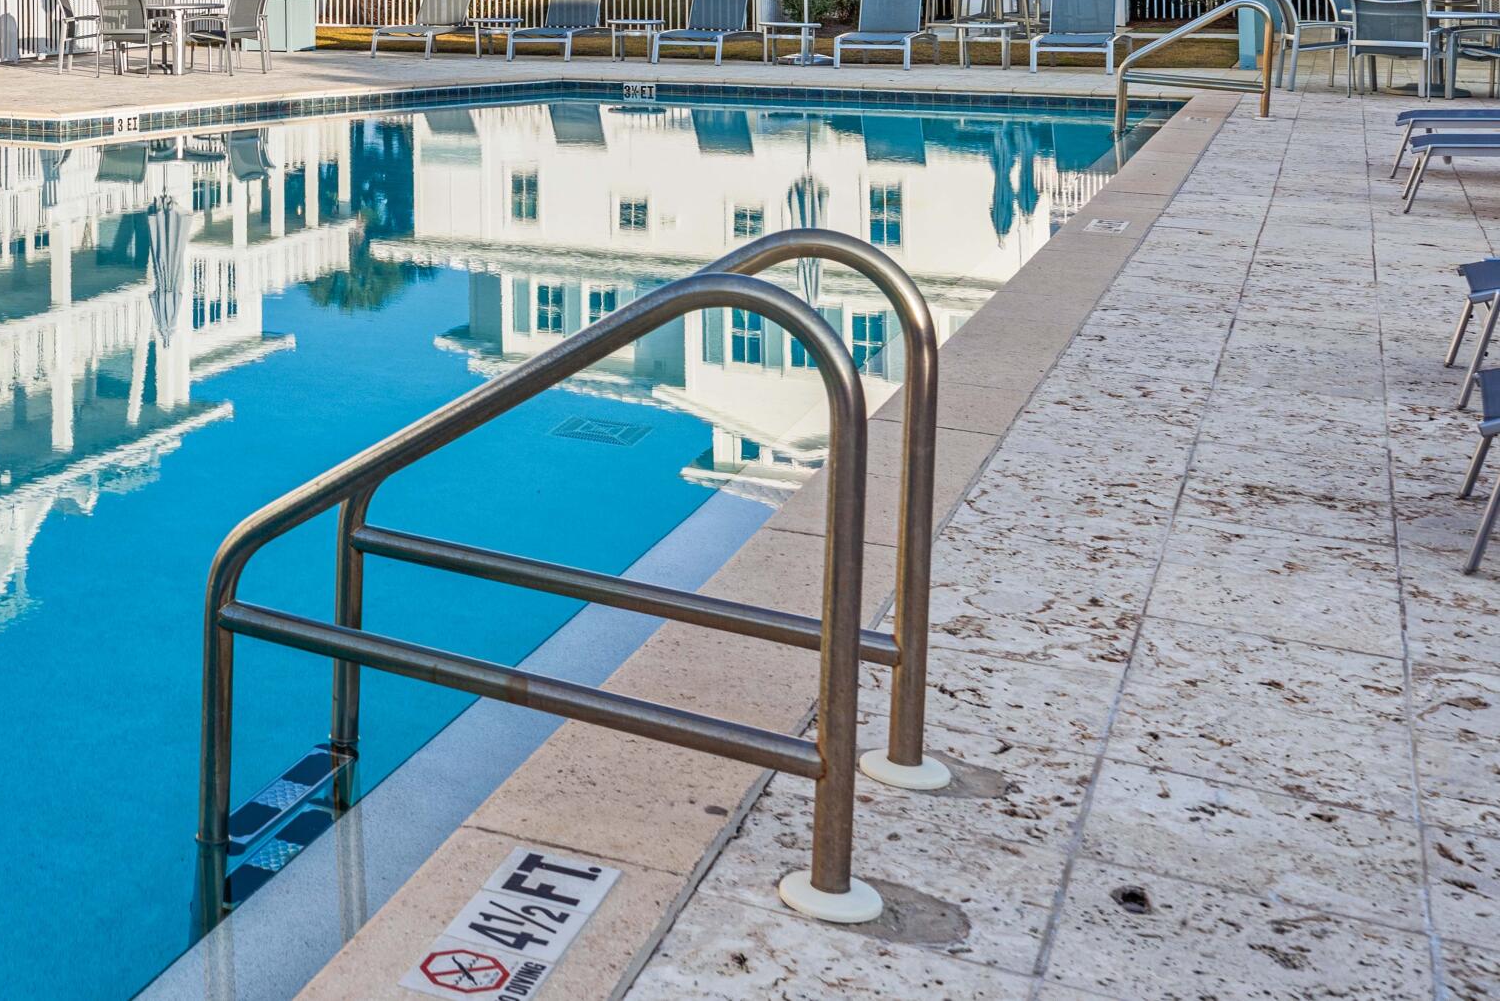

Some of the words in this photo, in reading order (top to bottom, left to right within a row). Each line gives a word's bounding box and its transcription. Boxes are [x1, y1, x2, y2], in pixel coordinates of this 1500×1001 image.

[117, 118, 123, 132] 3
[501, 853, 602, 907] FT.
[504, 961, 547, 996] DIVING
